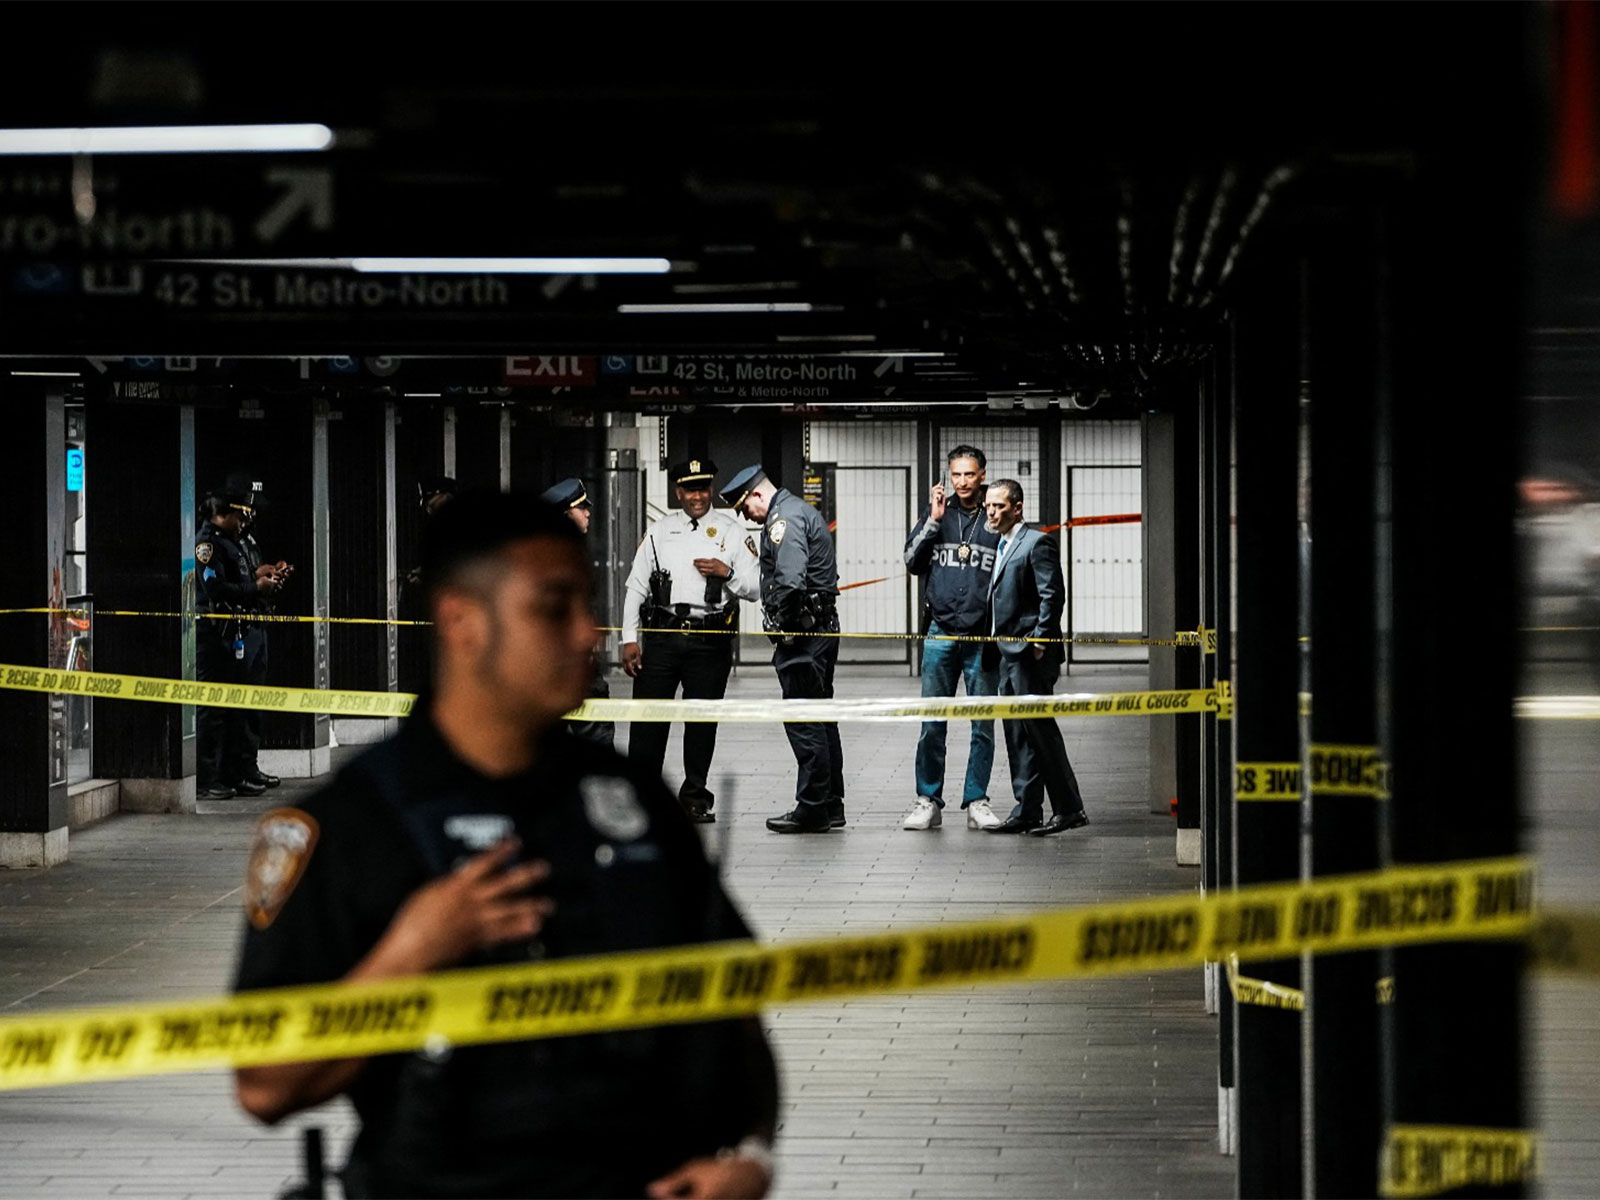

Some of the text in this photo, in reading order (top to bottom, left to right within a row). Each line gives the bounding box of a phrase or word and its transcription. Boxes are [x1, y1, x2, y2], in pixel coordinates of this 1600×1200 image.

[152, 271, 510, 312] 42 St, Metro-North
[673, 361, 858, 383] 42 St, Metro-North
[737, 386, 830, 398] & Metro-North
[929, 549, 996, 572] POLCE
